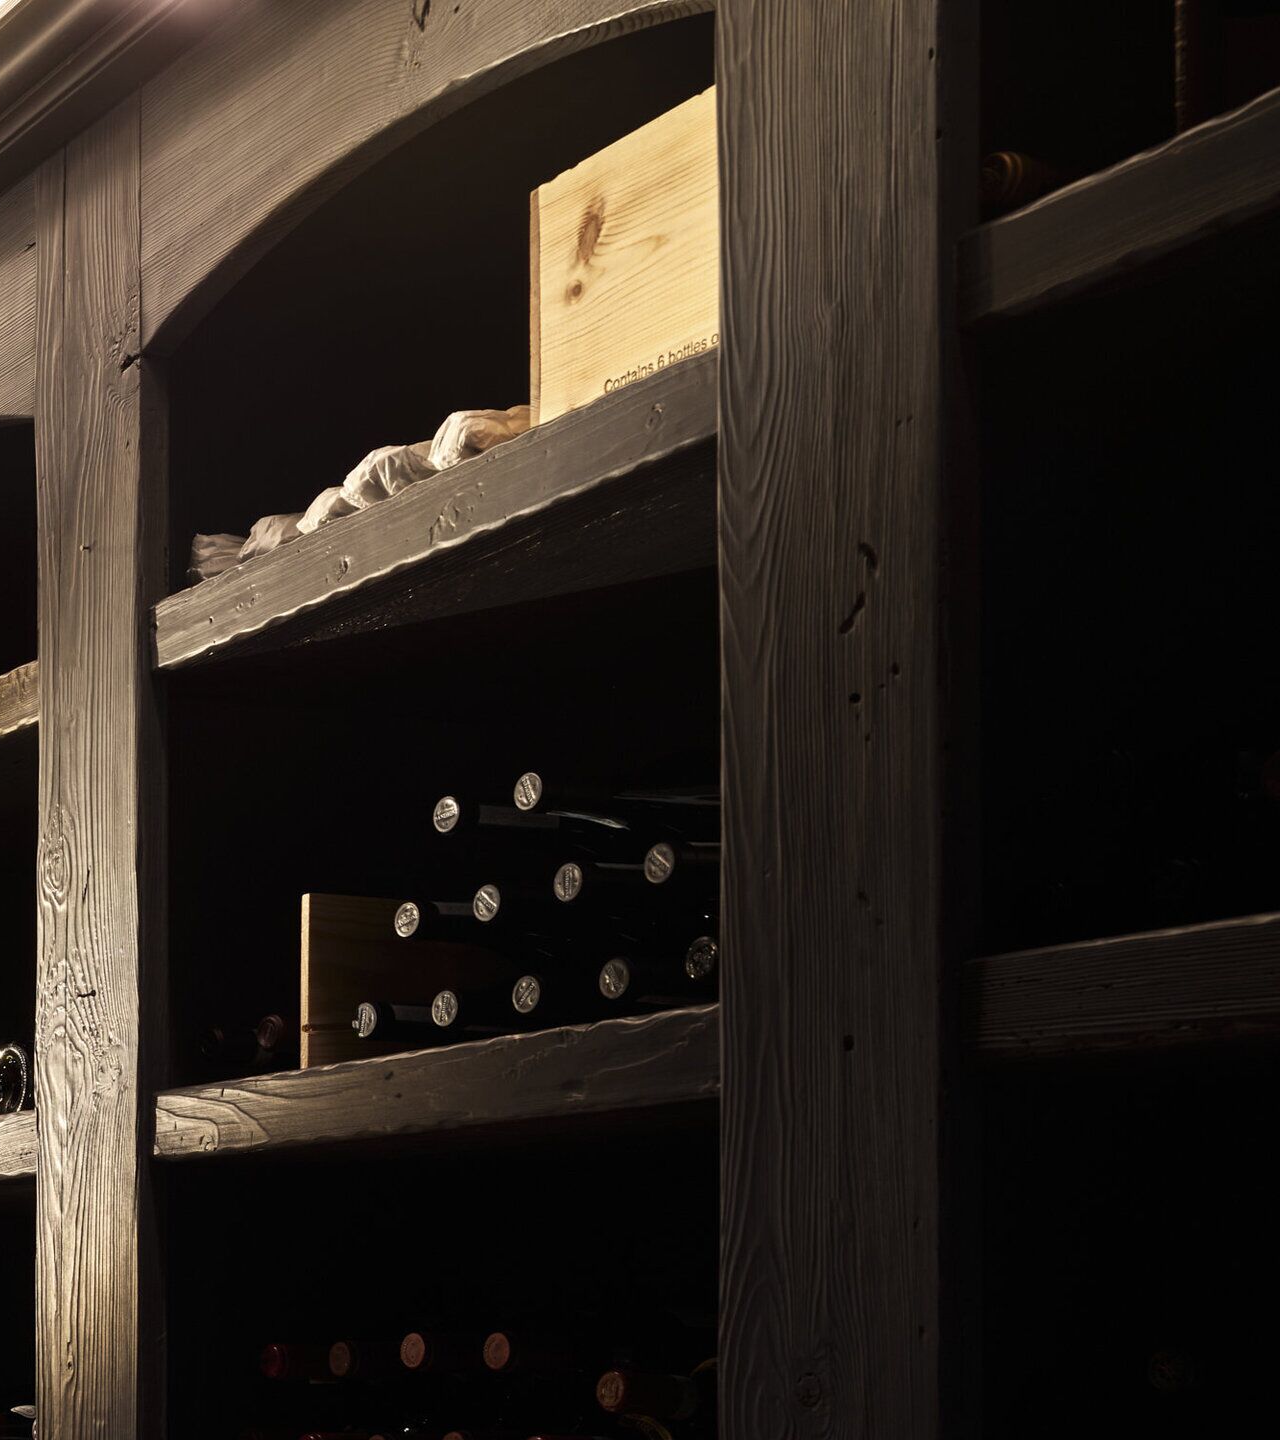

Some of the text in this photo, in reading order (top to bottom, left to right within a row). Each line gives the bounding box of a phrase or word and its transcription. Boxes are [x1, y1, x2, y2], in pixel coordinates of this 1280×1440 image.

[604, 362, 654, 394] Contains
[657, 354, 665, 369] 6
[668, 338, 707, 364] bottles
